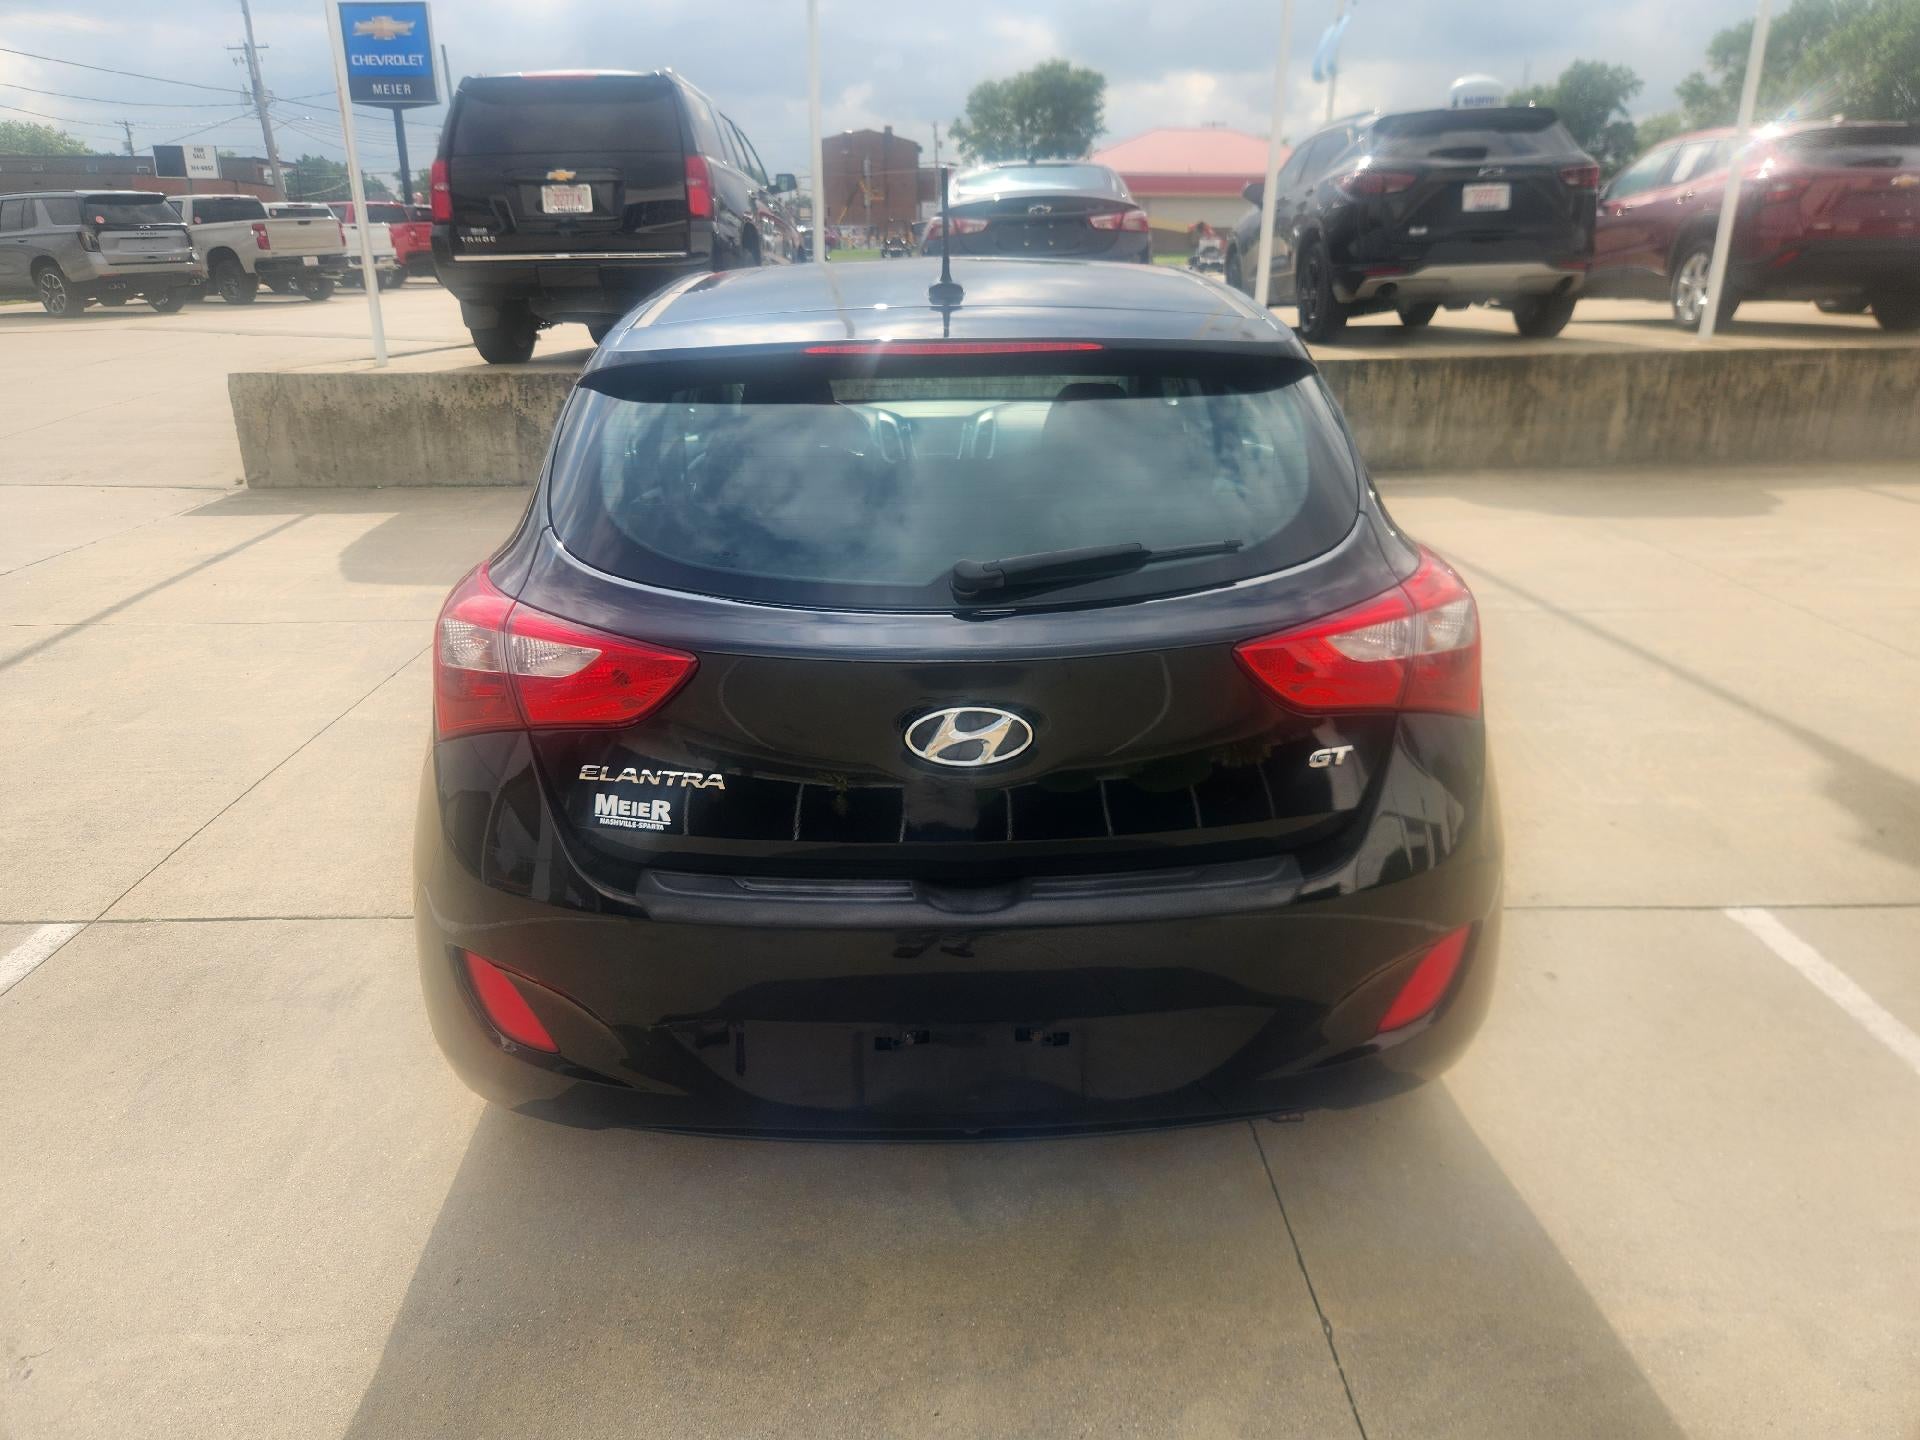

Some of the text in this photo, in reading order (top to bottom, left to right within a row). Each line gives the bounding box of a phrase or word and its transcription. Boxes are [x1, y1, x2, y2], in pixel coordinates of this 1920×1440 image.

[351, 54, 424, 66] CHEVROLET
[372, 83, 411, 95] MEIER
[1309, 745, 1354, 768] GT
[578, 764, 726, 790] ELANTRA
[599, 817, 665, 831] NASHVILLE-SPARTA
